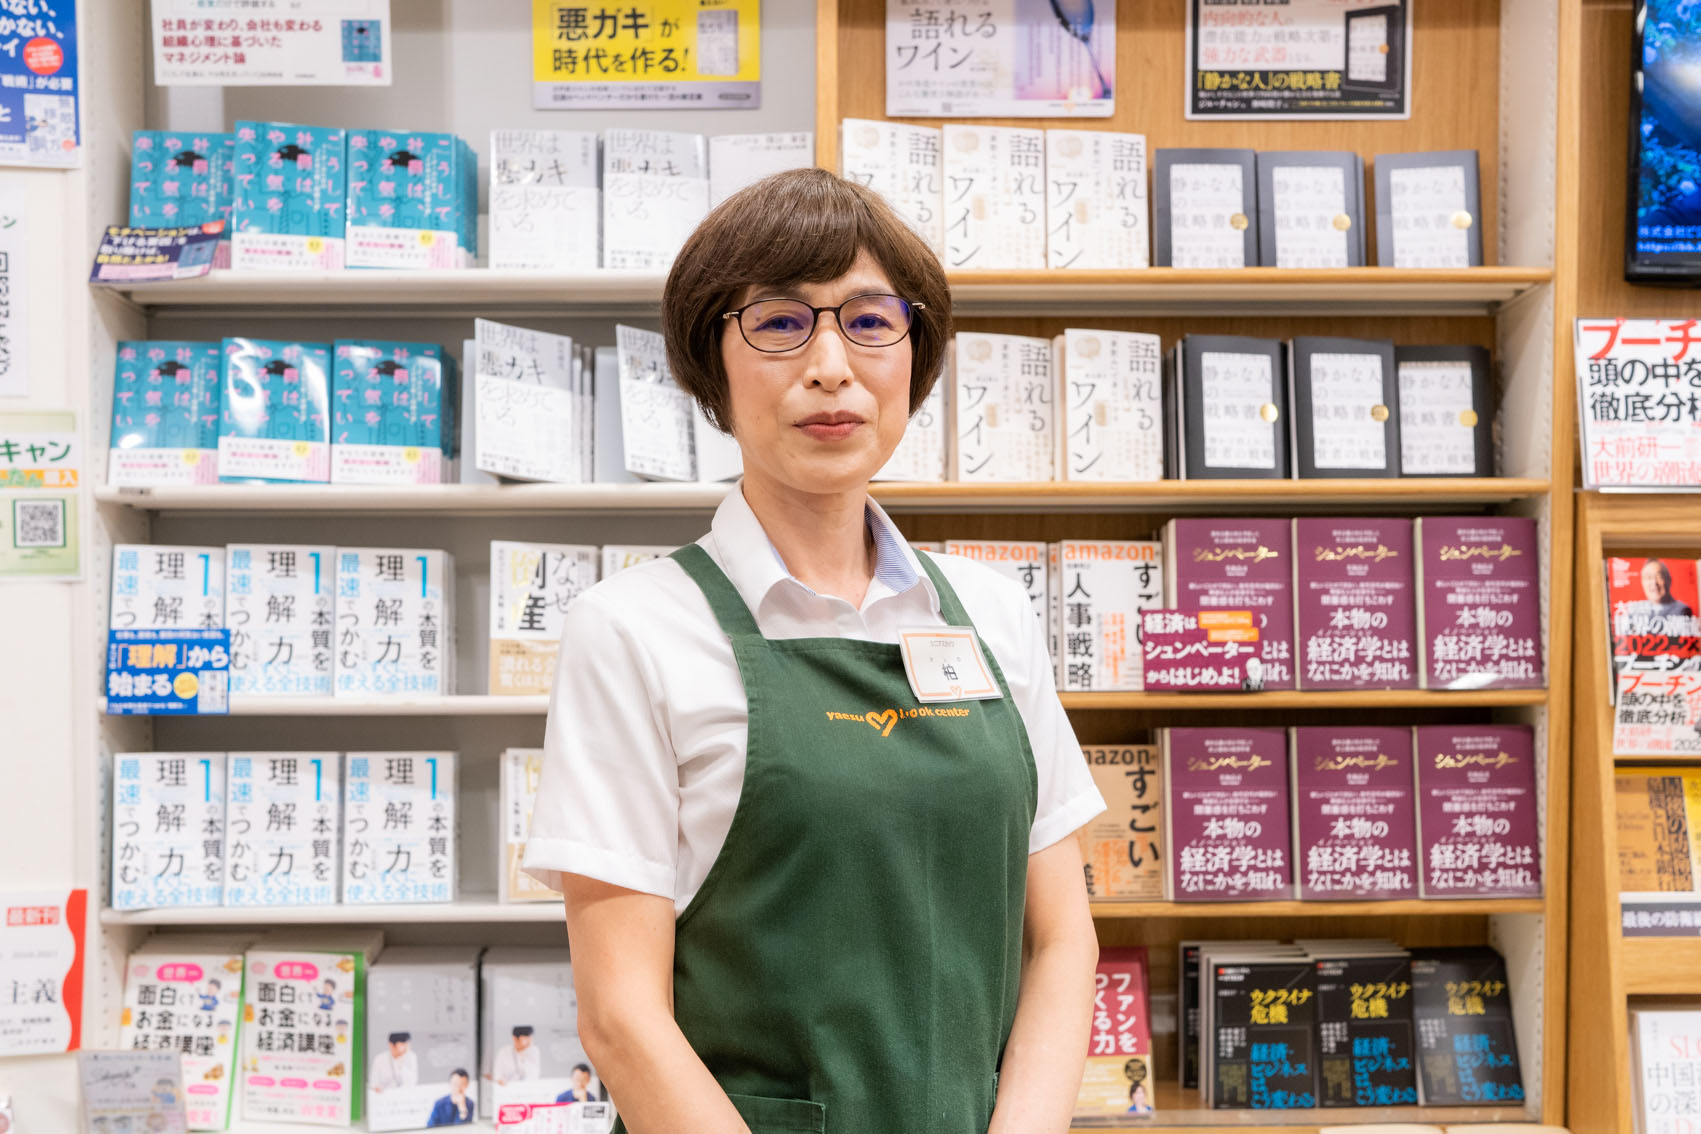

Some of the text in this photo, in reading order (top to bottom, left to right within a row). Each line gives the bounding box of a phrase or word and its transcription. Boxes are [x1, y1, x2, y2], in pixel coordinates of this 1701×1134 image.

[161, 19, 323, 32] 社員が変わり、会社も変わる
[909, 7, 997, 40] 語れる
[161, 35, 284, 48] 組織心理に基づいた
[163, 51, 246, 65] マネジメント論
[896, 42, 974, 72] ワイン
[323, 135, 342, 217] こうして
[434, 140, 452, 222] こうして
[909, 132, 940, 224] 語れる
[1009, 134, 1044, 225] 語れる
[1112, 139, 1145, 230] 語れる
[946, 175, 982, 268] ワイン
[1020, 343, 1053, 432] 語れる
[1128, 340, 1161, 432] 語れる
[958, 384, 994, 475] ワイン
[1068, 381, 1104, 474] ワイン
[1064, 543, 1156, 562] amazon
[265, 550, 297, 665] 理解力
[374, 554, 405, 665] 理解力
[1330, 607, 1388, 630] 本物の
[1456, 605, 1514, 628] 本物の
[1066, 572, 1094, 689] 人事戦略
[1143, 612, 1198, 635] 経済は
[1144, 640, 1255, 661] シュンペーター
[1307, 634, 1411, 662] 経済学とは
[1433, 633, 1536, 661] 経済学とは
[942, 663, 959, 681] 柏
[1146, 666, 1241, 687] からはじめよ!
[1307, 661, 1411, 682] なにかを知れ
[108, 671, 173, 698] 始まる
[826, 711, 866, 723] yaesu
[934, 707, 970, 718] center
[1619, 709, 1687, 726] 徹底分析
[154, 758, 188, 878] 理解力
[265, 758, 299, 877] 理解力
[383, 758, 415, 875] 理解力
[1125, 766, 1160, 869] すごい
[1202, 816, 1262, 840] 本物の
[1330, 816, 1389, 839] 本物の
[1451, 813, 1511, 837] 本物の
[1181, 845, 1285, 872] 経済学とは
[1307, 844, 1412, 872] 経済学とは
[1429, 842, 1534, 870] 経済学とは
[1181, 870, 1285, 893] なにかを知れ
[1308, 869, 1412, 892] なにかを知れ
[1431, 867, 1534, 889] なにかを知れ
[1250, 988, 1314, 1007] ウクライナ
[1349, 981, 1412, 1000] ウクライナ
[1445, 979, 1505, 998] ウクライナ
[258, 1007, 333, 1028] お金になる
[1093, 973, 1117, 1055] つくる力
[1111, 972, 1138, 1054] ファンを
[1250, 1003, 1289, 1025] 危機
[1350, 996, 1389, 1019] 危機
[1448, 994, 1486, 1017] 危機
[135, 1010, 214, 1031] お金になる
[256, 1030, 336, 1055] 経済講座
[1250, 1060, 1308, 1079] ビジネス
[1354, 1054, 1411, 1073] ビジネス
